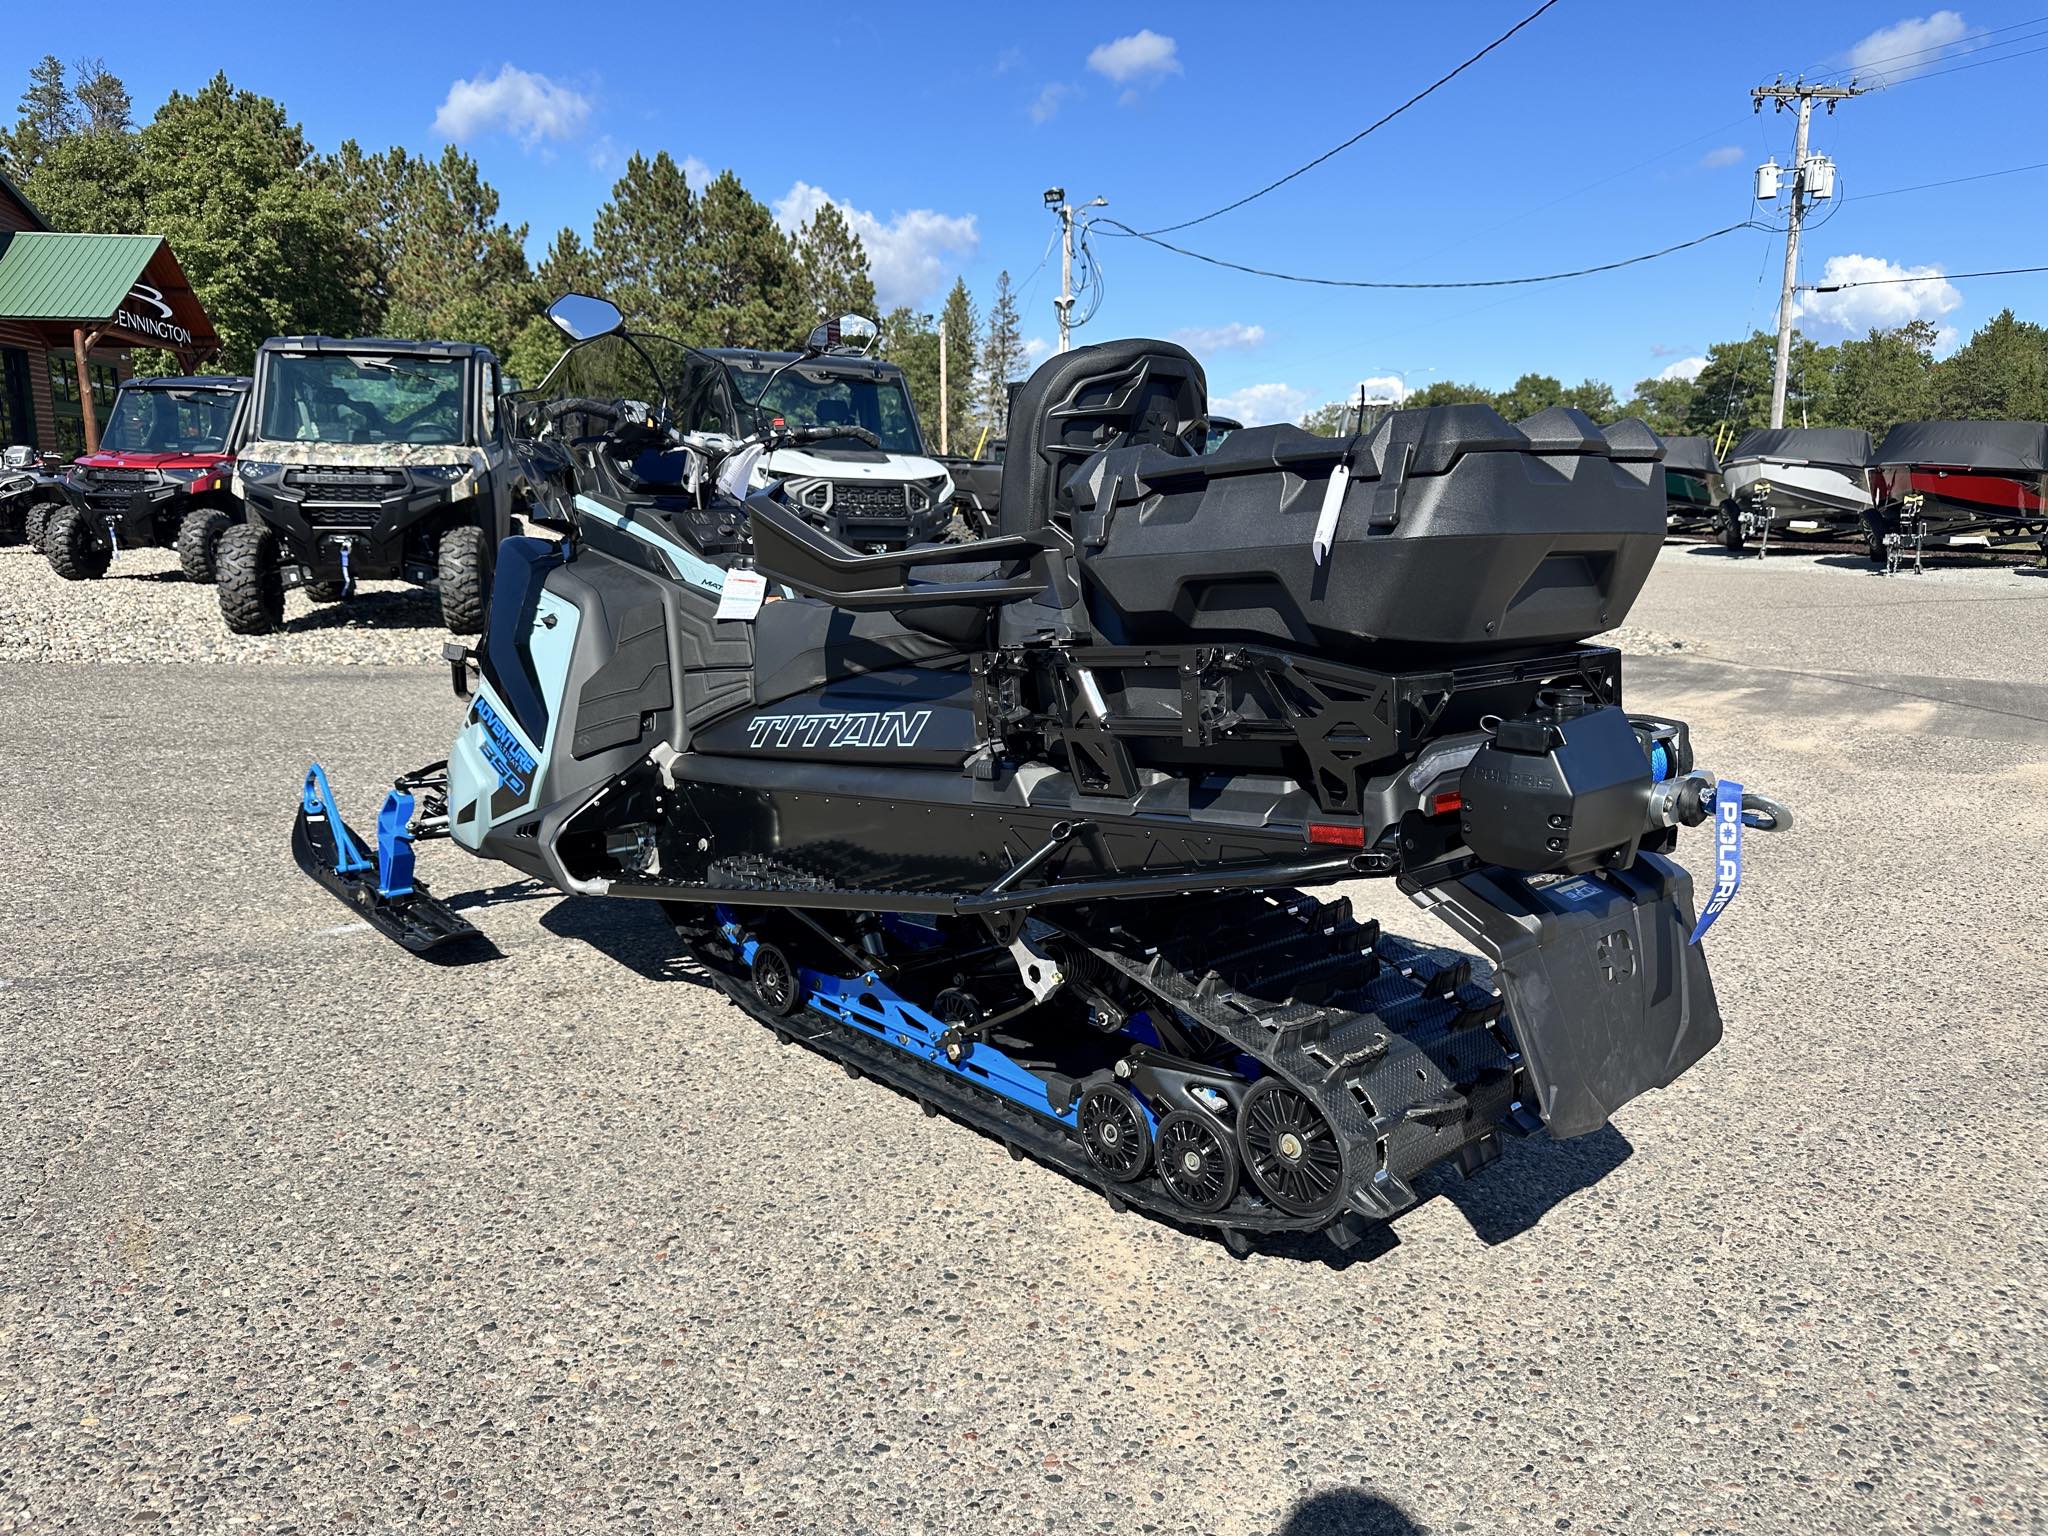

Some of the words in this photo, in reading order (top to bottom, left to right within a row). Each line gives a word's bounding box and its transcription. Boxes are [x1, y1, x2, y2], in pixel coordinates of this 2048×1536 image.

[114, 309, 192, 345] ENNINGTON
[836, 493, 902, 504] POLARIS
[701, 579, 724, 591] MAT
[475, 698, 537, 775] ADVENTURE
[747, 710, 933, 748] TITAN
[1707, 801, 1738, 915] POLARIS
